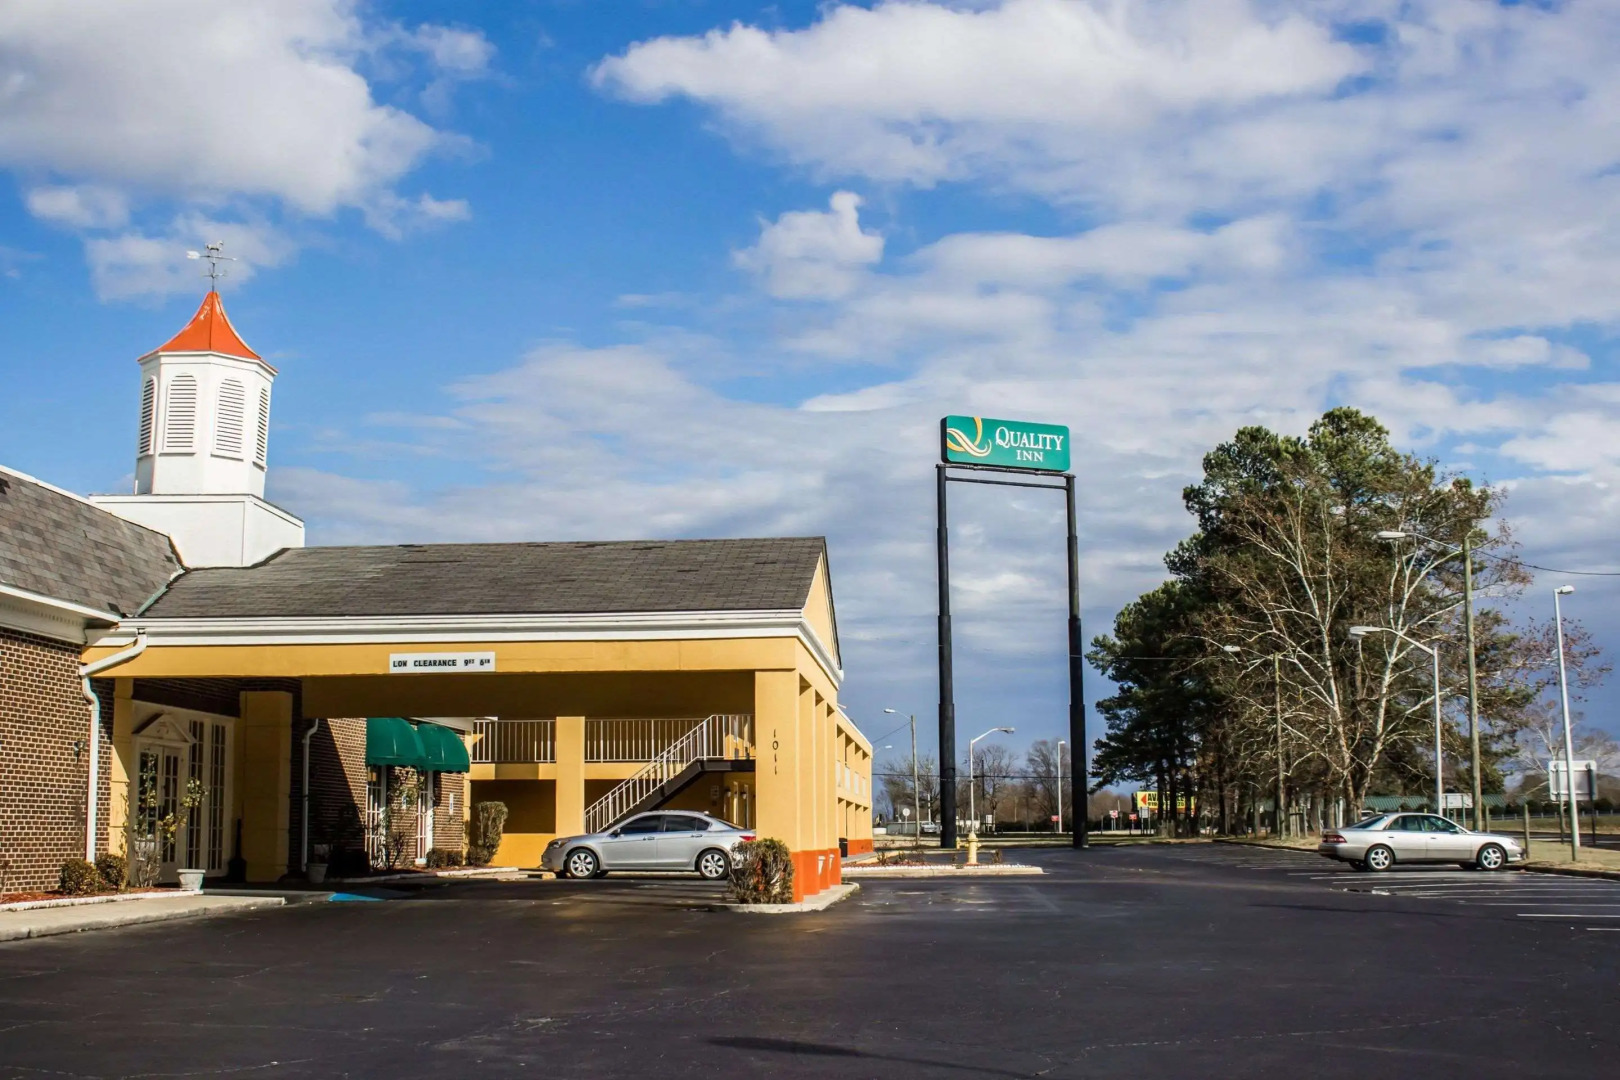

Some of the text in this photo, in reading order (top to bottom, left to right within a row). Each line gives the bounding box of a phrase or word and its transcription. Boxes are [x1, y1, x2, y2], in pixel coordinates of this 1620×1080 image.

[995, 426, 1064, 450] QUALITY
[1016, 449, 1044, 462] INN
[393, 660, 407, 668] LOW
[413, 659, 457, 667] CLEARANCE
